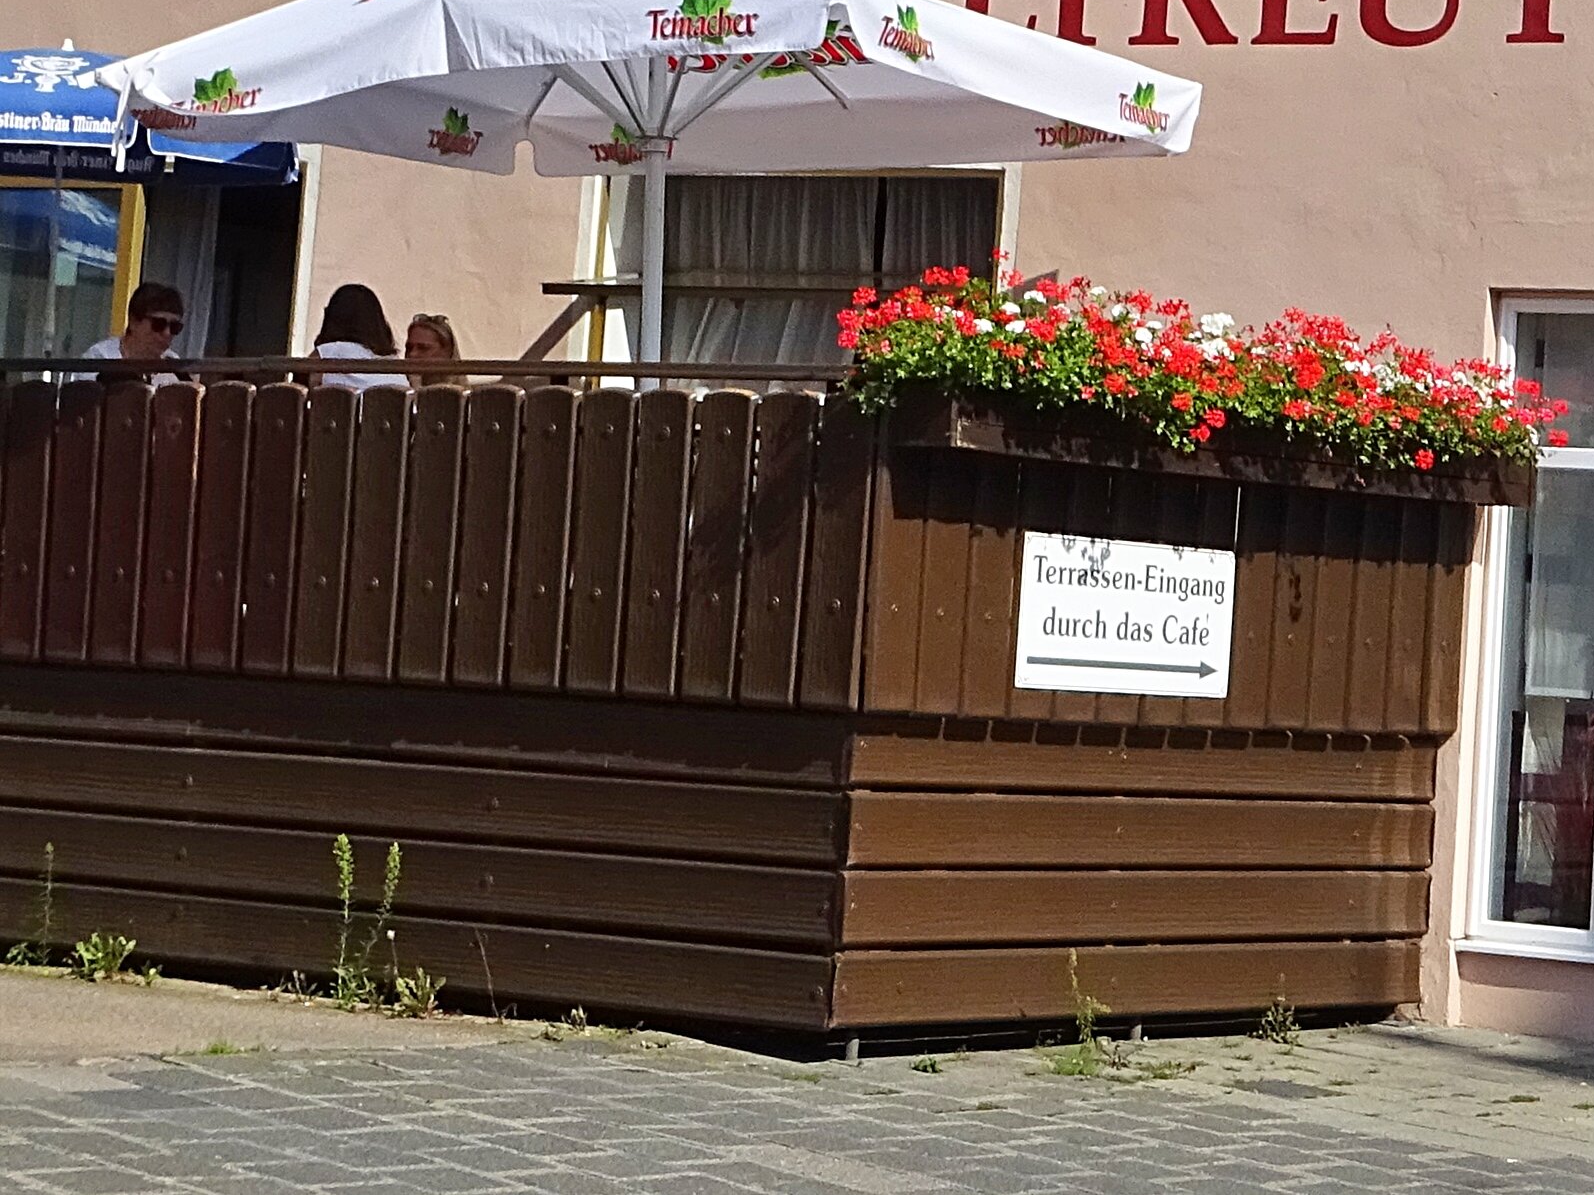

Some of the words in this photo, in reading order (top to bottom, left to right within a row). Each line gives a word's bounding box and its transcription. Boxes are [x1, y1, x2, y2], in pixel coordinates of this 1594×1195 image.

[645, 7, 760, 41] Teinacher
[72, 115, 123, 134] Münche
[1033, 555, 1226, 605] Terrassen-Eingang
[1042, 606, 1107, 640] durch
[1116, 611, 1154, 643] das
